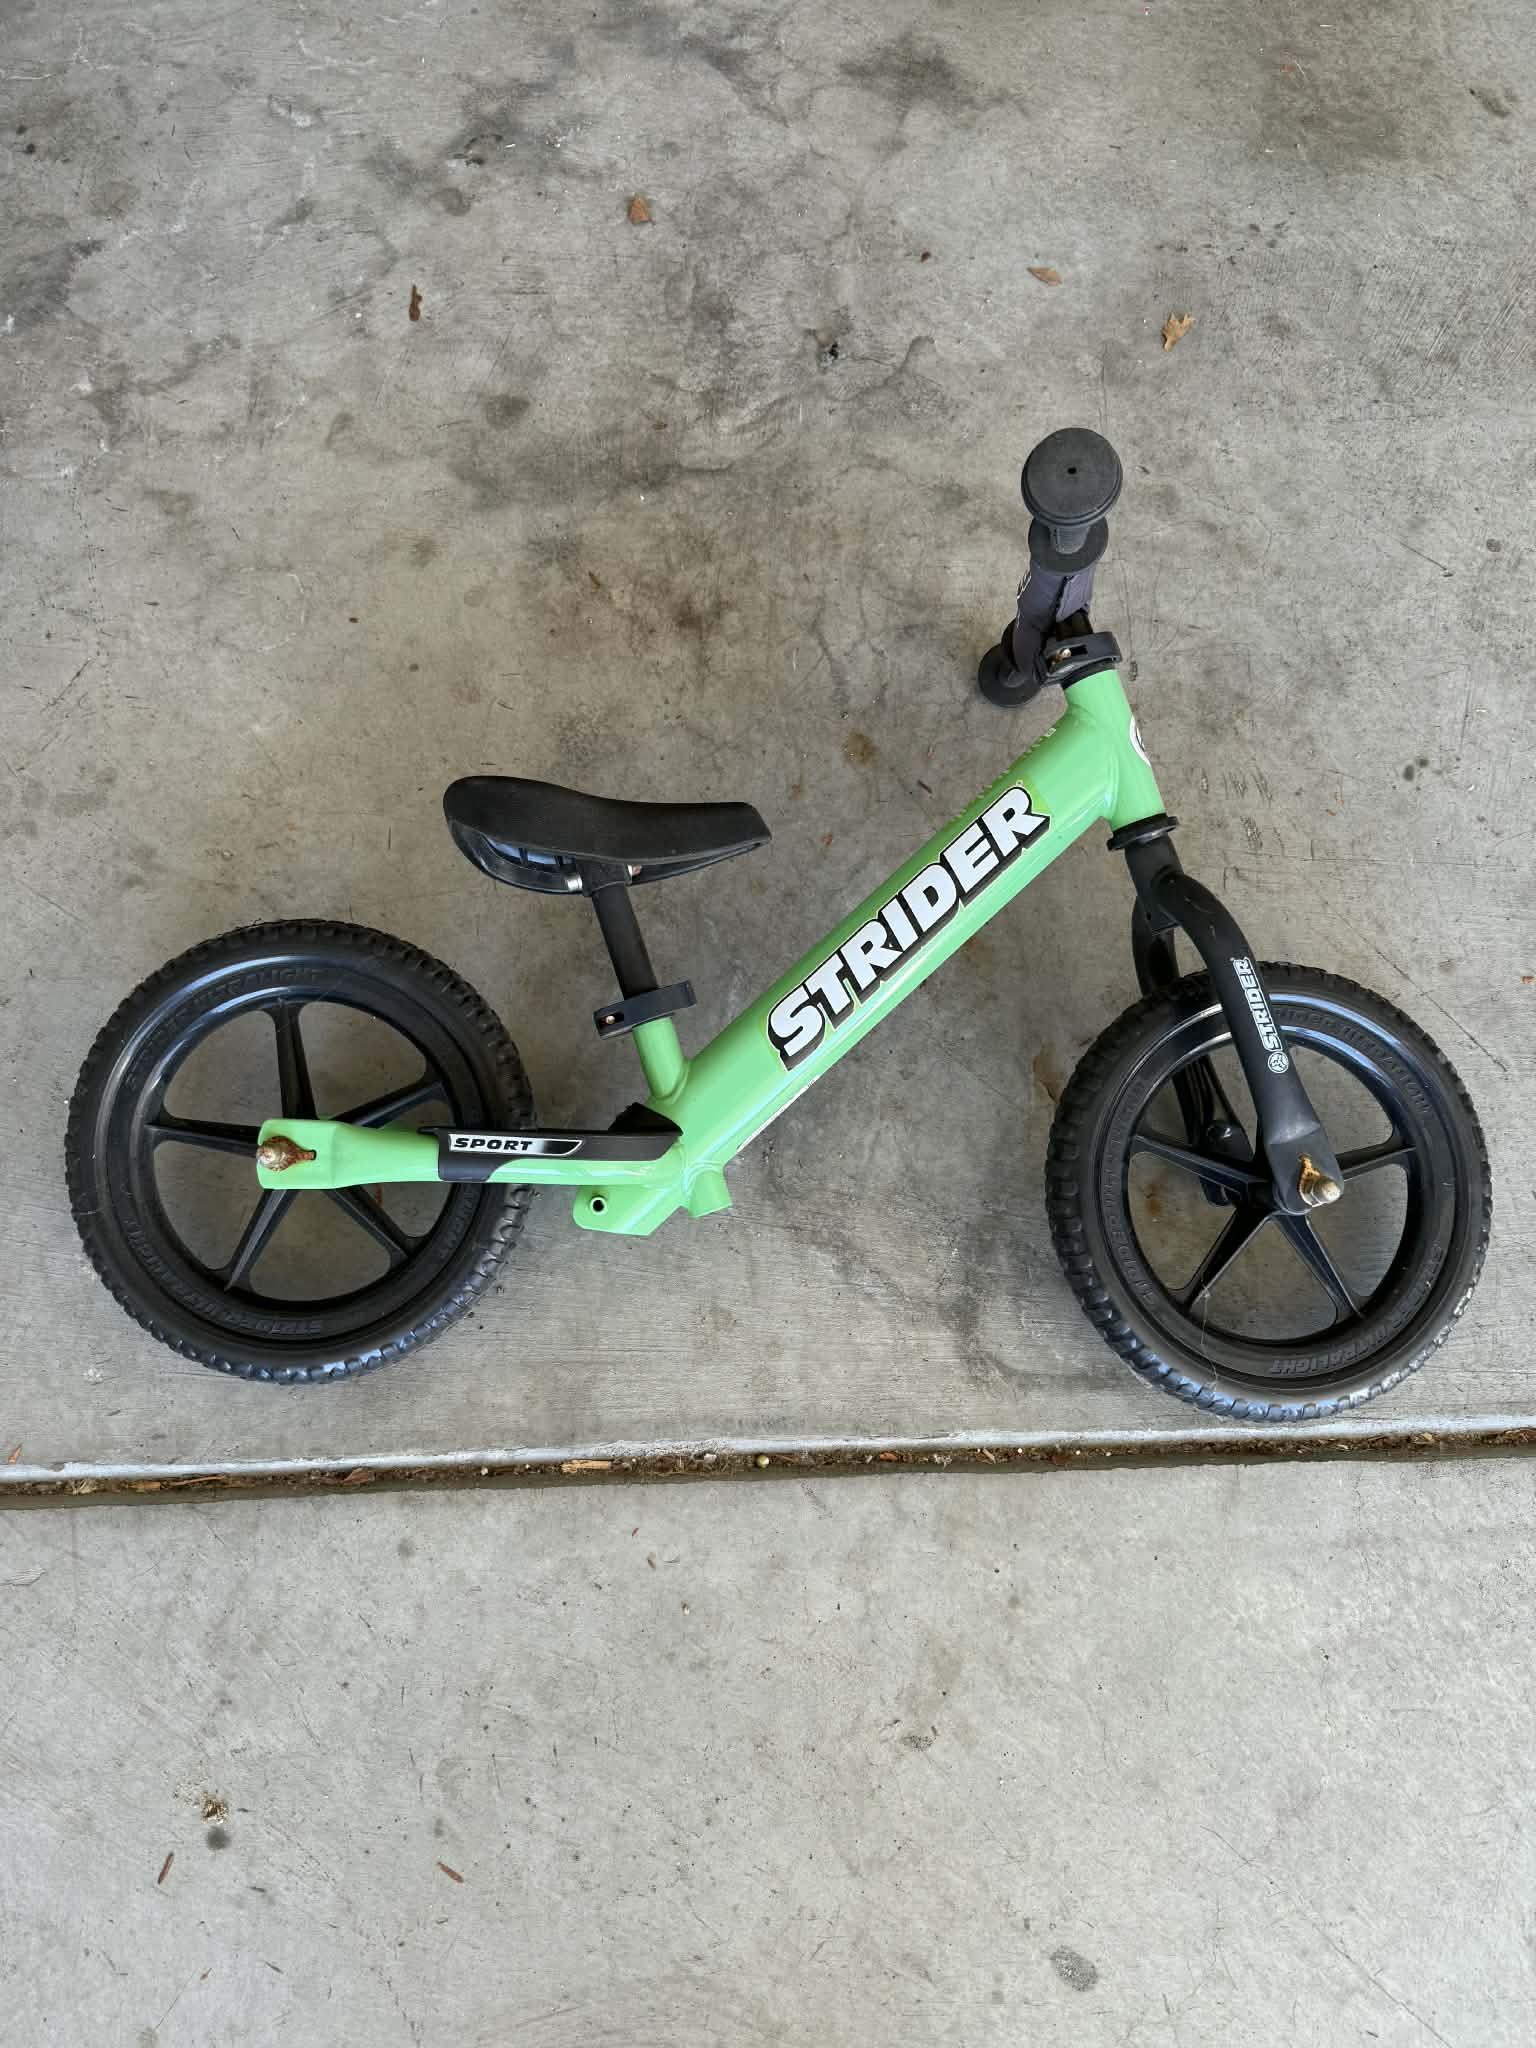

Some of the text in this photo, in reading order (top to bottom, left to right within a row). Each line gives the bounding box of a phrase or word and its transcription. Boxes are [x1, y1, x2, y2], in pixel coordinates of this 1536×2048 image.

[768, 787, 1050, 1071] STRIDER
[1233, 957, 1282, 1051] STRIDER
[453, 1137, 533, 1151] SPORT
